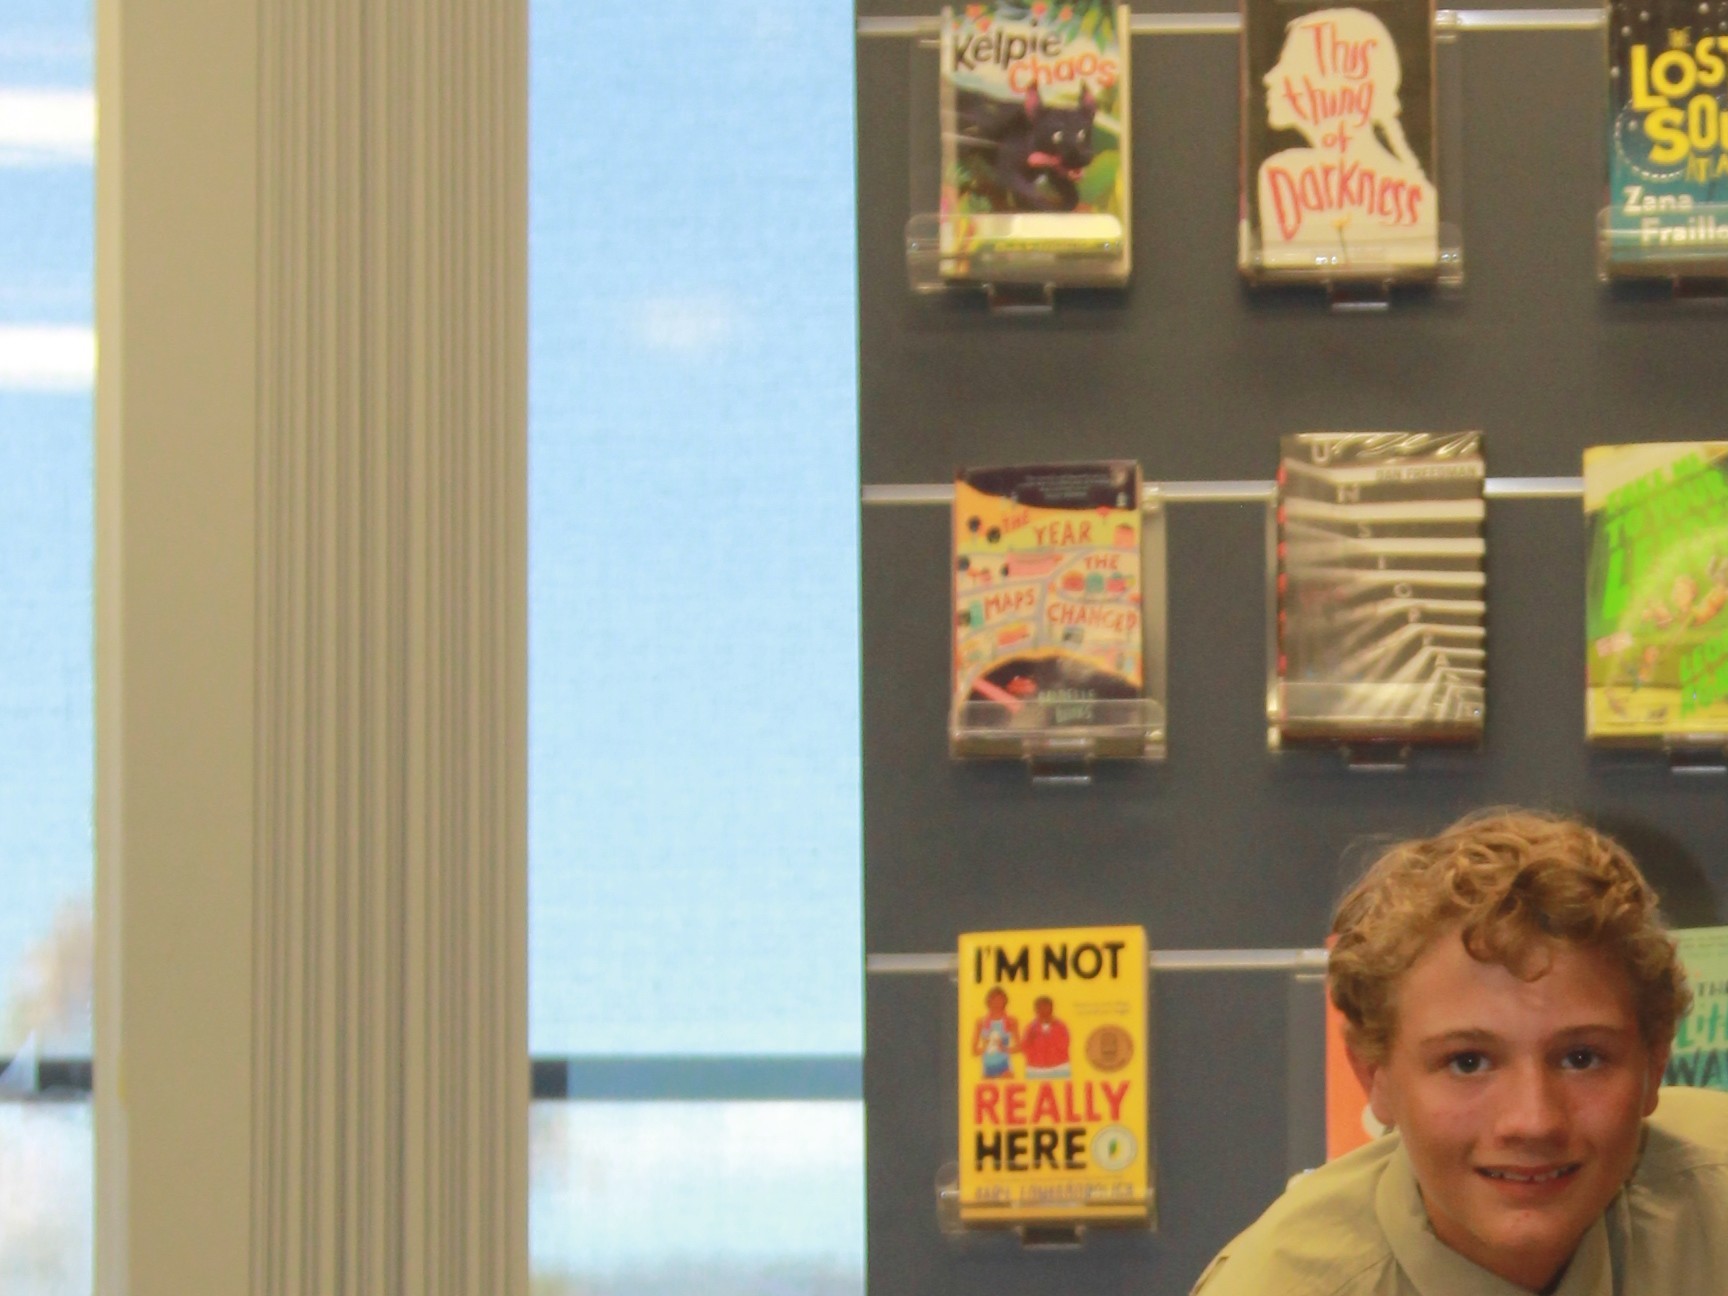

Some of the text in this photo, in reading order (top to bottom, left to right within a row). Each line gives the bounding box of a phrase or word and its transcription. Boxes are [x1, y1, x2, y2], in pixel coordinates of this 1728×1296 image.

[953, 19, 1062, 71] Kelpie
[1301, 20, 1378, 80] This
[1321, 119, 1352, 153] of
[1266, 160, 1423, 241] Darkness
[1623, 185, 1693, 216] Zana
[1033, 520, 1111, 546] YEAR
[1084, 553, 1119, 571] THE
[984, 587, 1035, 622] MAPS
[1046, 602, 1138, 631] CHANGED
[974, 941, 1125, 984] I'M NOT
[974, 1080, 1130, 1126] REALLY
[974, 1128, 1087, 1172] HERE
